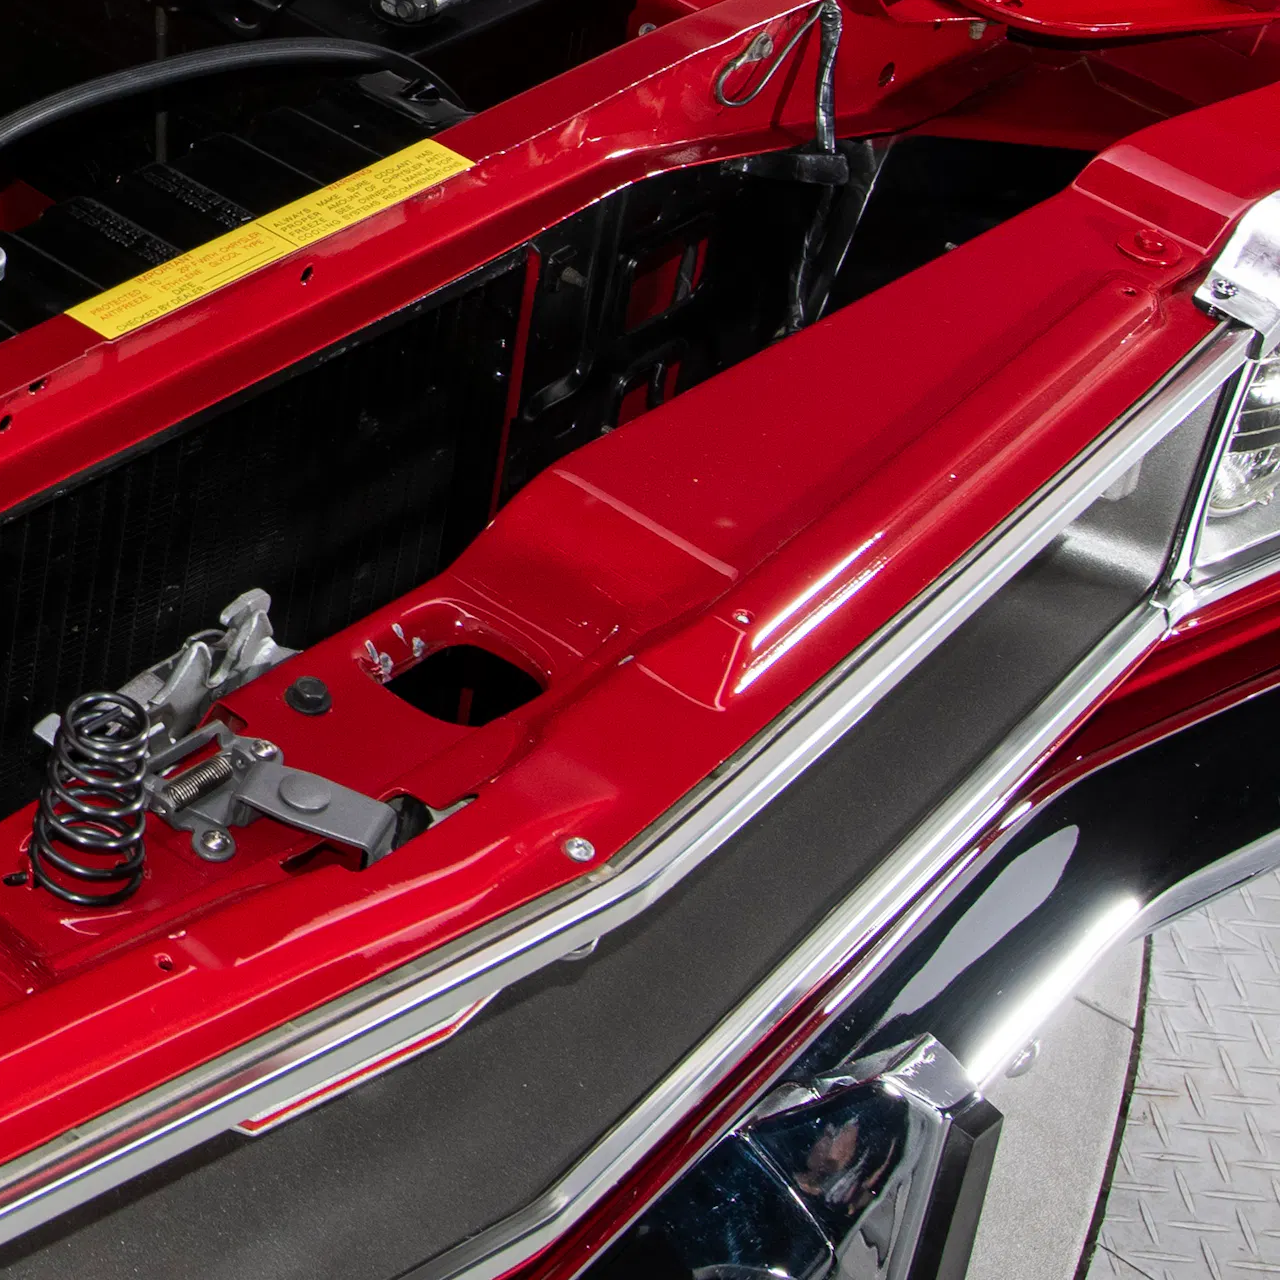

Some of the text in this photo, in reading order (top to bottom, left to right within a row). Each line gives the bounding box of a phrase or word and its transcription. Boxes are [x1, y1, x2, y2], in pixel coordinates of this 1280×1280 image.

[269, 148, 434, 228] ALWAYS MAKE SURE COOLANT HAS
[277, 210, 323, 233] PROPER
[324, 190, 364, 211] AMOUNT
[379, 161, 426, 184] CHRYSLER
[286, 216, 329, 237] FREEZE
[399, 164, 438, 183] MANUAL
[294, 160, 464, 242] COOLING SYSTEMS RECOMMENDATIONS
[86, 288, 144, 316] PROTECTED
[216, 230, 262, 253] CHRYSLER
[95, 293, 153, 321] ANTIFREEZE
[205, 249, 242, 268] GLYCOL
[132, 253, 196, 284] IMPORTANT
[168, 280, 198, 295] DATE
[112, 307, 162, 332] CHECKED
[168, 285, 208, 305] DEALER
